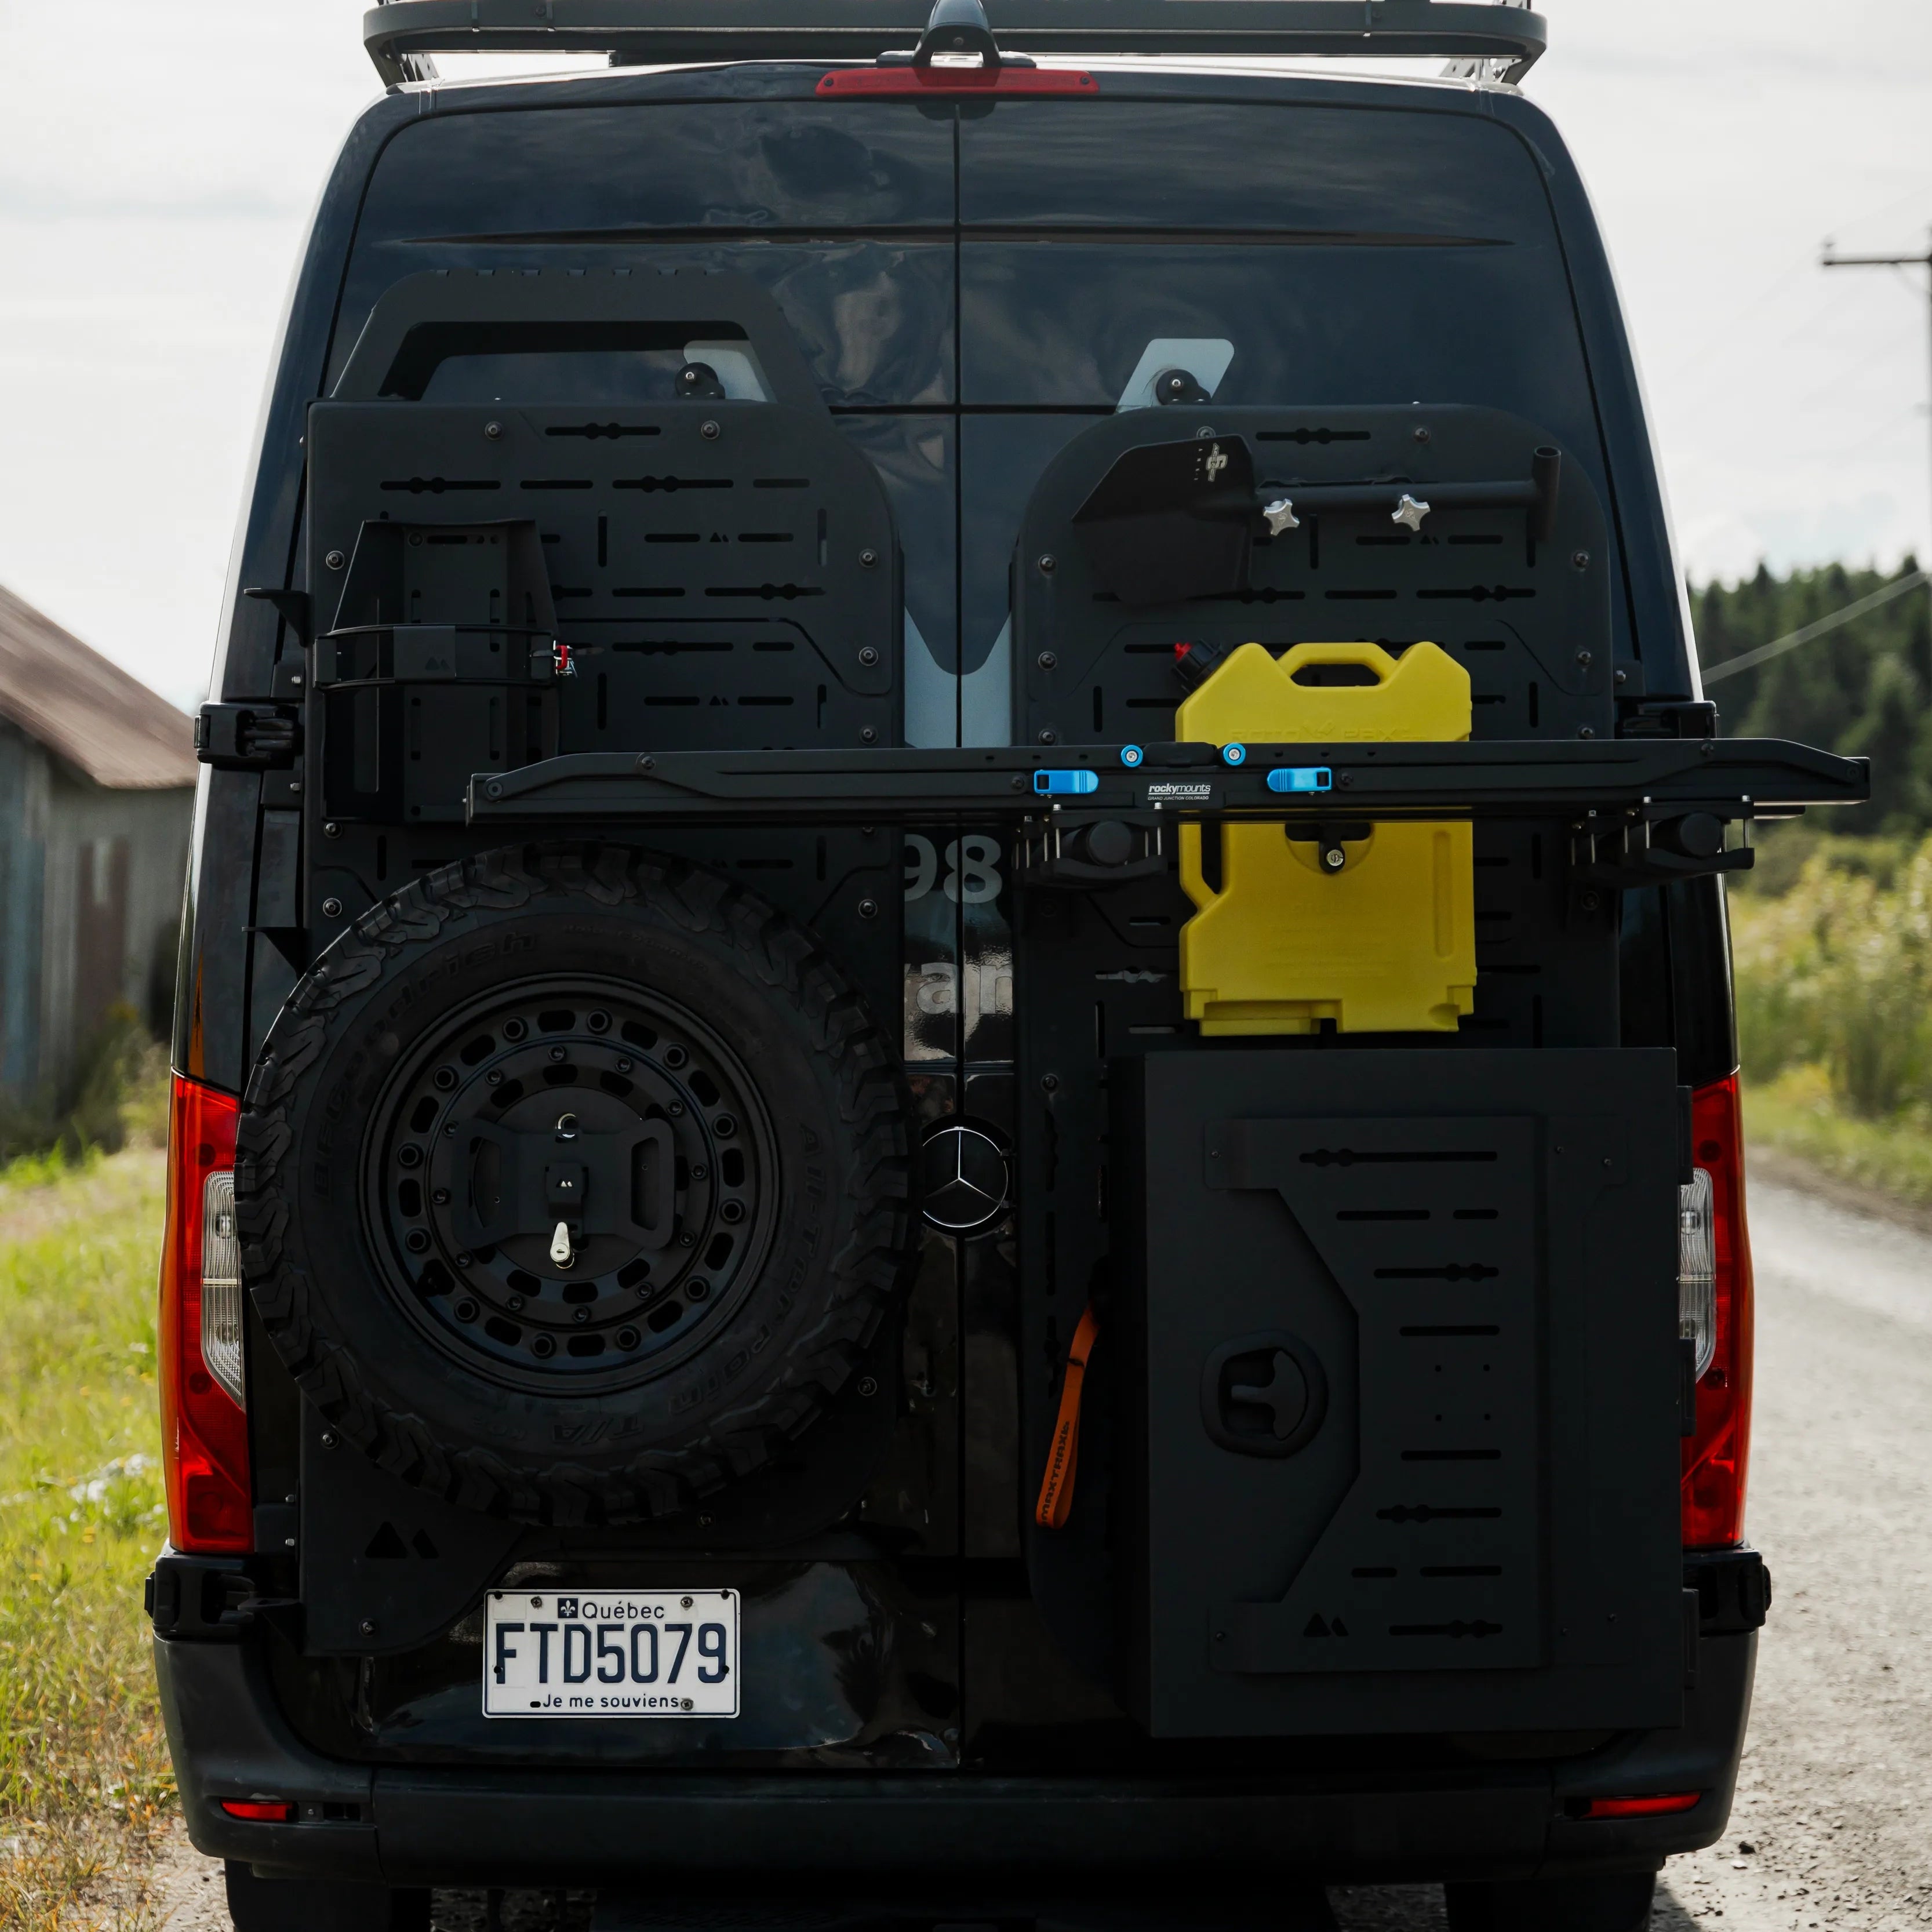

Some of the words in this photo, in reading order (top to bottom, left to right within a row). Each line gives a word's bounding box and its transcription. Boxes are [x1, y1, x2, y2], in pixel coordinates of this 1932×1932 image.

[1149, 783, 1211, 795] rockymounts
[582, 1601, 665, 1619] Québec
[496, 1623, 726, 1683] FTD5079
[543, 1694, 562, 1708] Je
[569, 1697, 594, 1708] me
[601, 1693, 679, 1708] souviens
